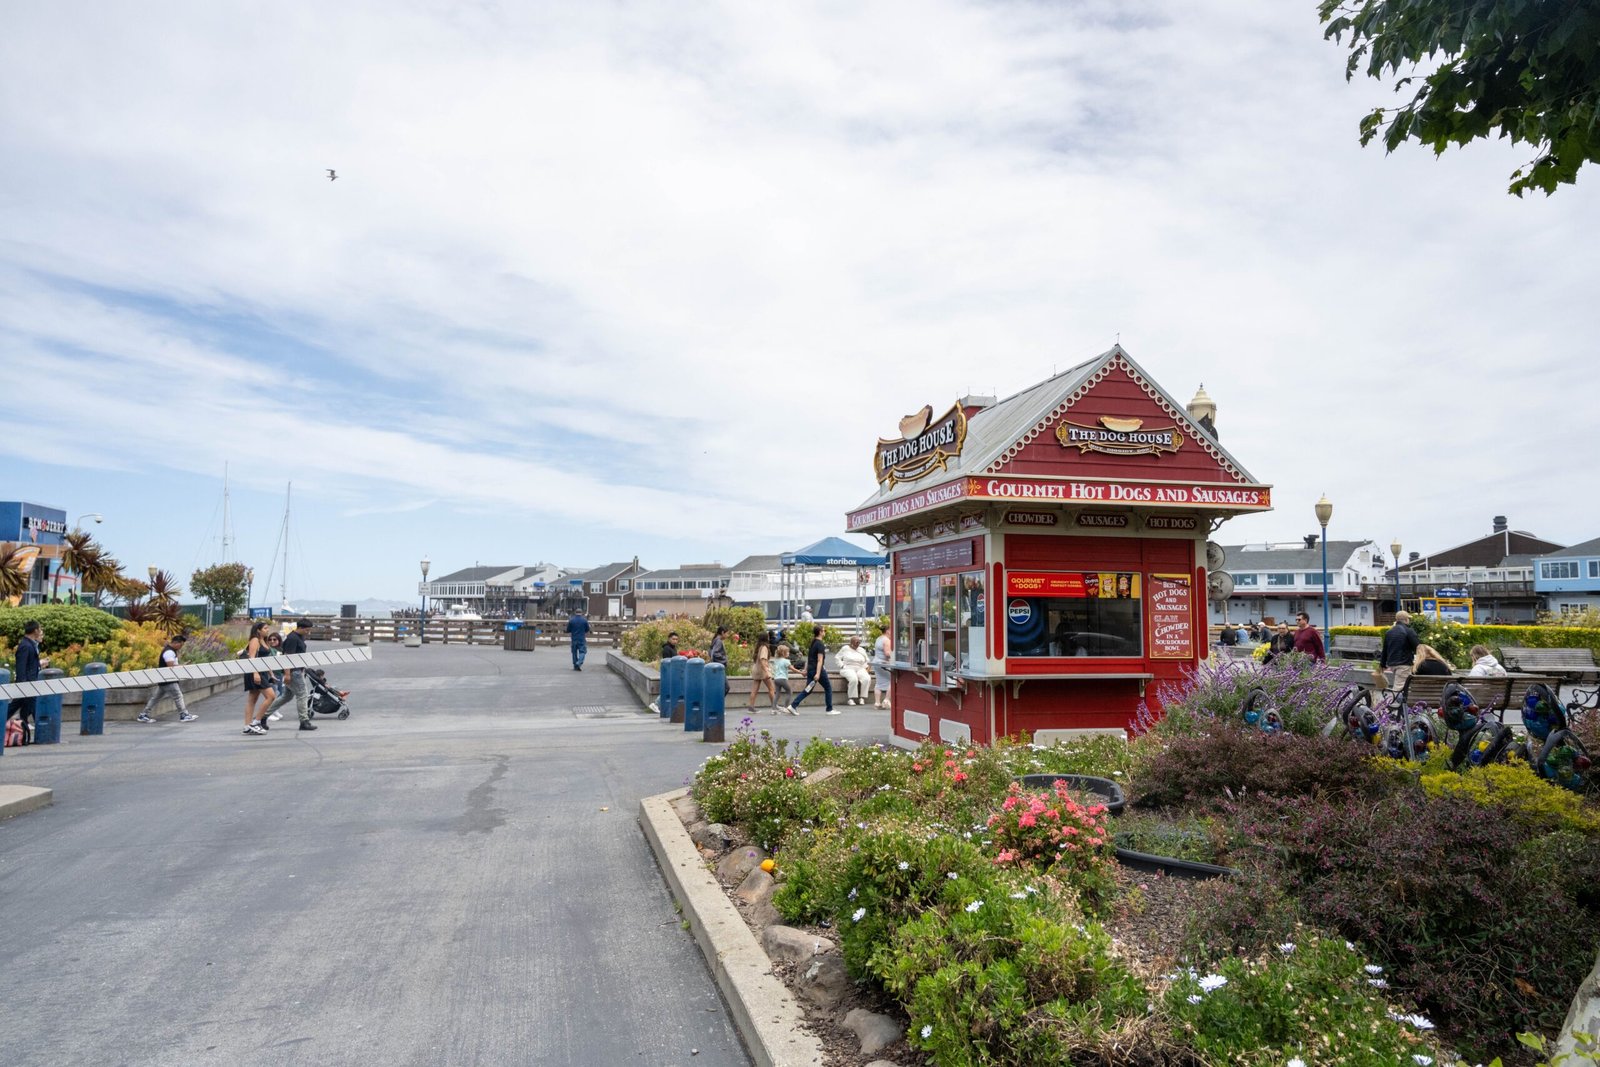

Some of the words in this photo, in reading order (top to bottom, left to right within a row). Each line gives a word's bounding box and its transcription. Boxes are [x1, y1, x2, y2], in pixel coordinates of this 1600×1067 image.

[1069, 428, 1097, 440] THE
[1100, 431, 1126, 442] DOG
[1128, 433, 1172, 445] HOUSE
[881, 448, 898, 469] THE
[899, 440, 918, 461] DOG
[919, 420, 954, 453] HOUSE
[987, 480, 1065, 498] GOURMET
[1069, 482, 1104, 499] HOT
[1109, 484, 1151, 501] DOGS
[1155, 488, 1188, 502] AND
[1191, 486, 1259, 504] SAUSAGES
[851, 510, 877, 528] GOURMET
[877, 506, 890, 520] HOT
[892, 500, 909, 516] DOGS
[910, 495, 925, 510] AND
[926, 483, 961, 506] SAUSAGES
[1008, 513, 1054, 524] CHOWDER
[1080, 515, 1125, 526] SAUSAGES
[1150, 517, 1168, 527] HOT
[1171, 518, 1195, 528] DOGS
[1153, 590, 1167, 602] HOT
[1010, 607, 1030, 615] PEPSI
[1156, 603, 1187, 611] SAUSAGES
[1155, 622, 1189, 637] CHOWDER
